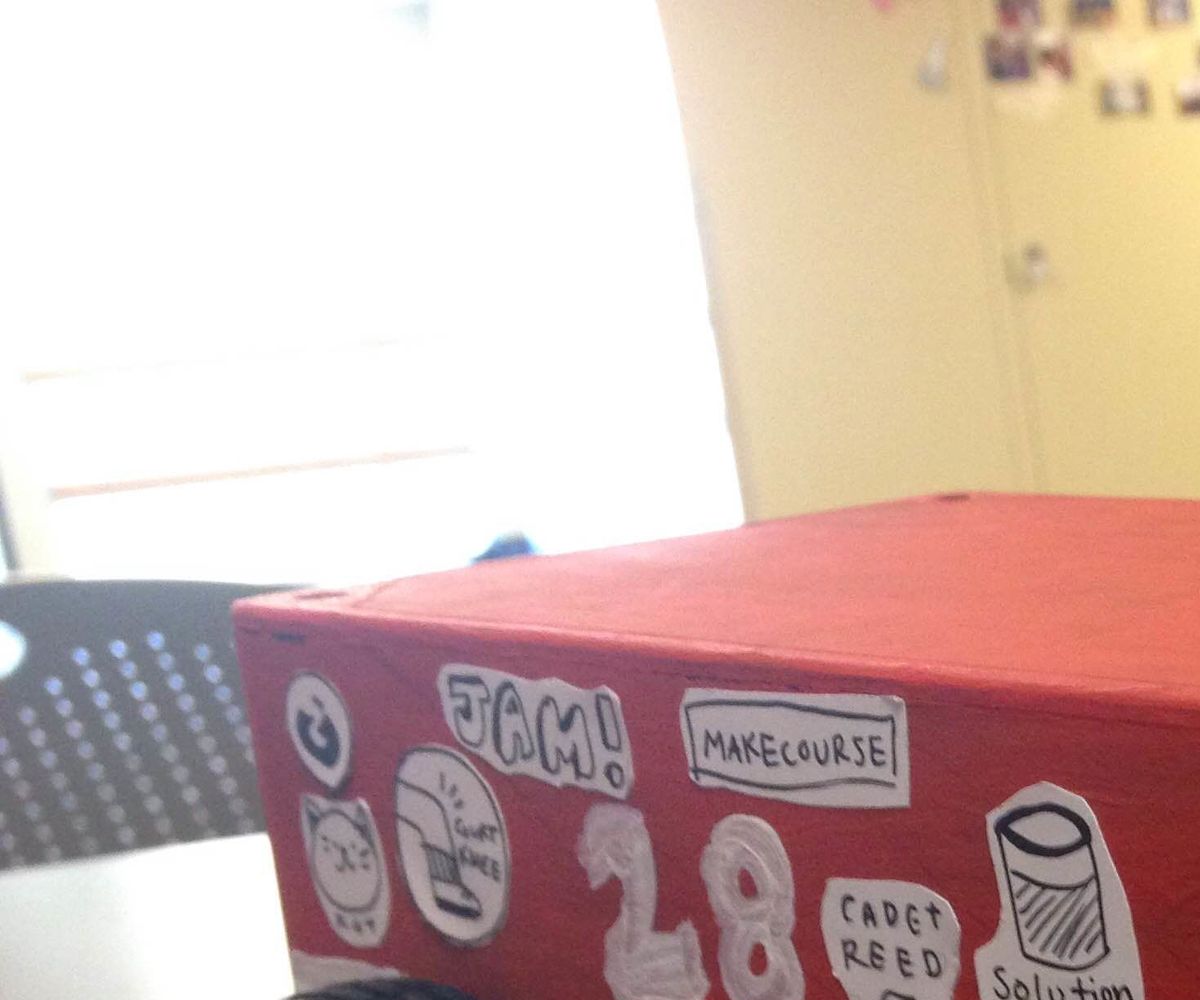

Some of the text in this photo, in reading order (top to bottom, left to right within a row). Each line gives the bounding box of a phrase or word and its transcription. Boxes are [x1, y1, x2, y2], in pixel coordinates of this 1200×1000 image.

[447, 672, 625, 790] JAM!
[703, 728, 887, 770] MAKECOURSE
[840, 937, 943, 979] REED
